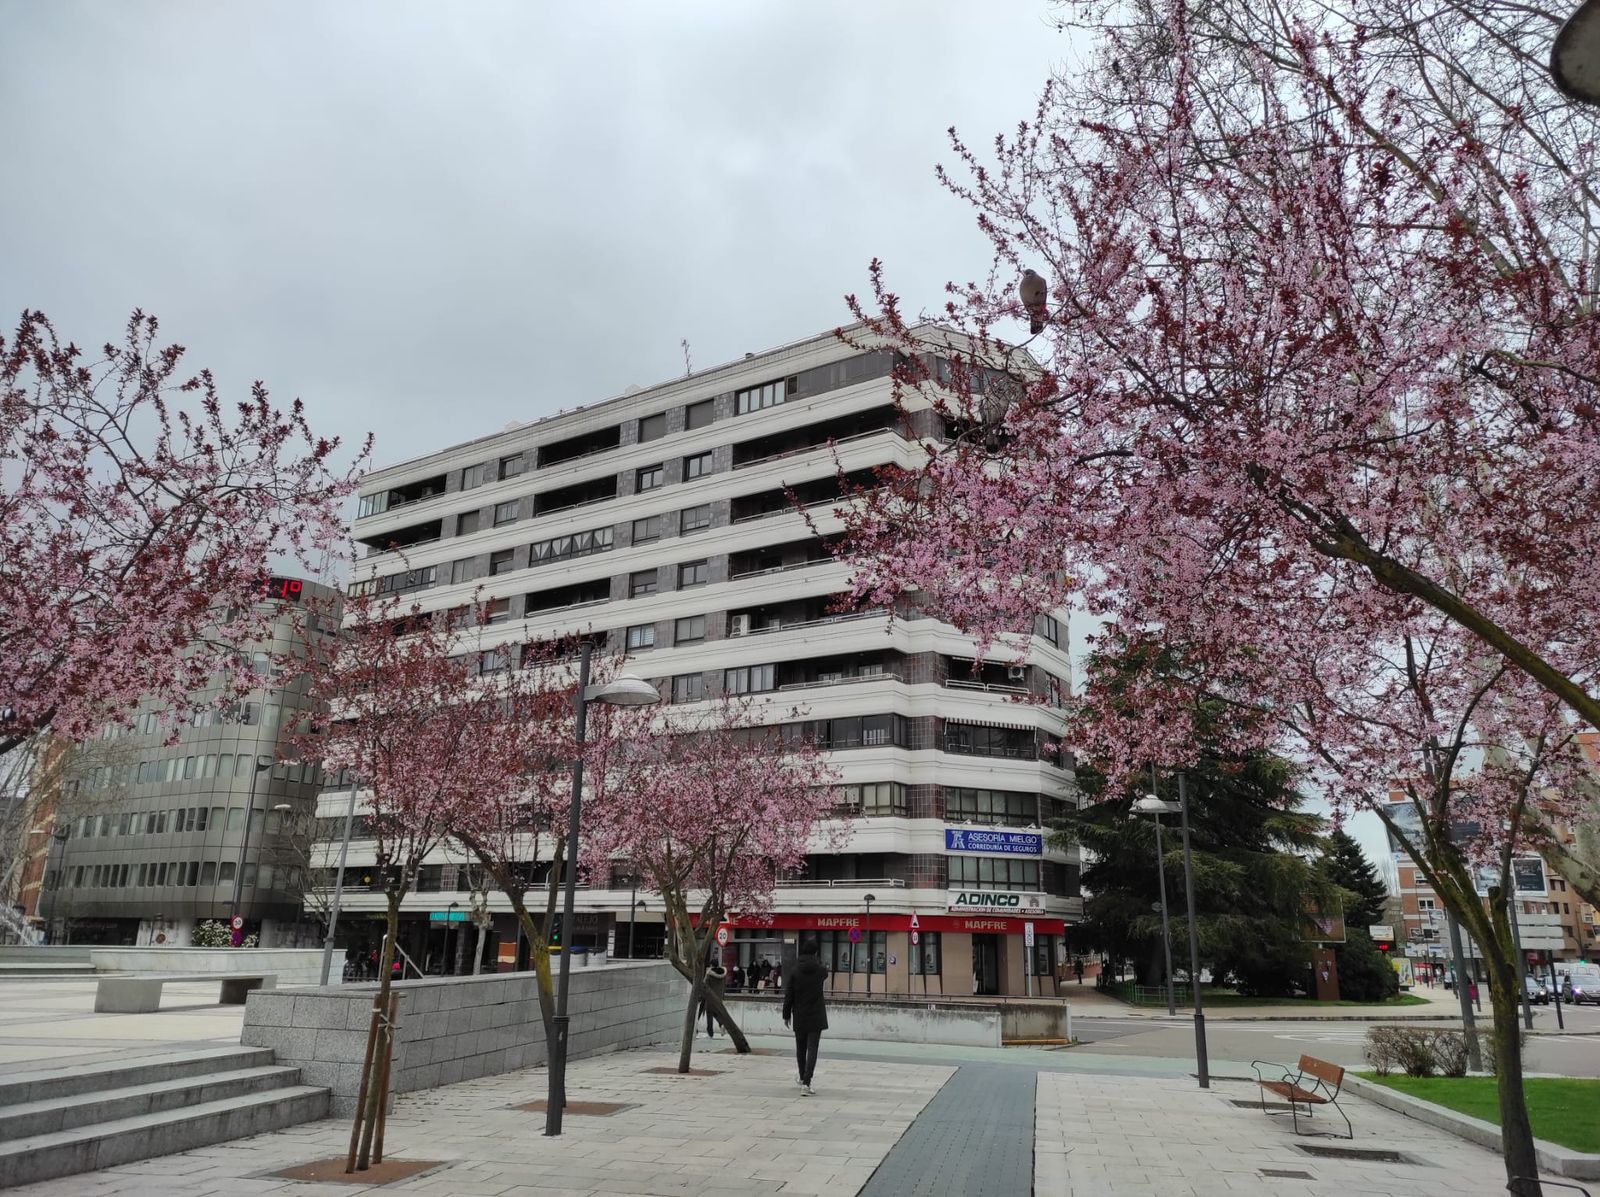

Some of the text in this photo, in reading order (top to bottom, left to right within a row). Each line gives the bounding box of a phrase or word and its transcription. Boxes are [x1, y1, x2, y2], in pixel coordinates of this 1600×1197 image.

[968, 832, 1037, 844] ASESORÍA MIELGO
[968, 842, 1037, 853] CORREDURÍA DE SEGUROS
[955, 893, 1020, 907] ADINCO
[817, 918, 860, 927] MAPFRE
[965, 920, 1007, 930] MAPFRE
